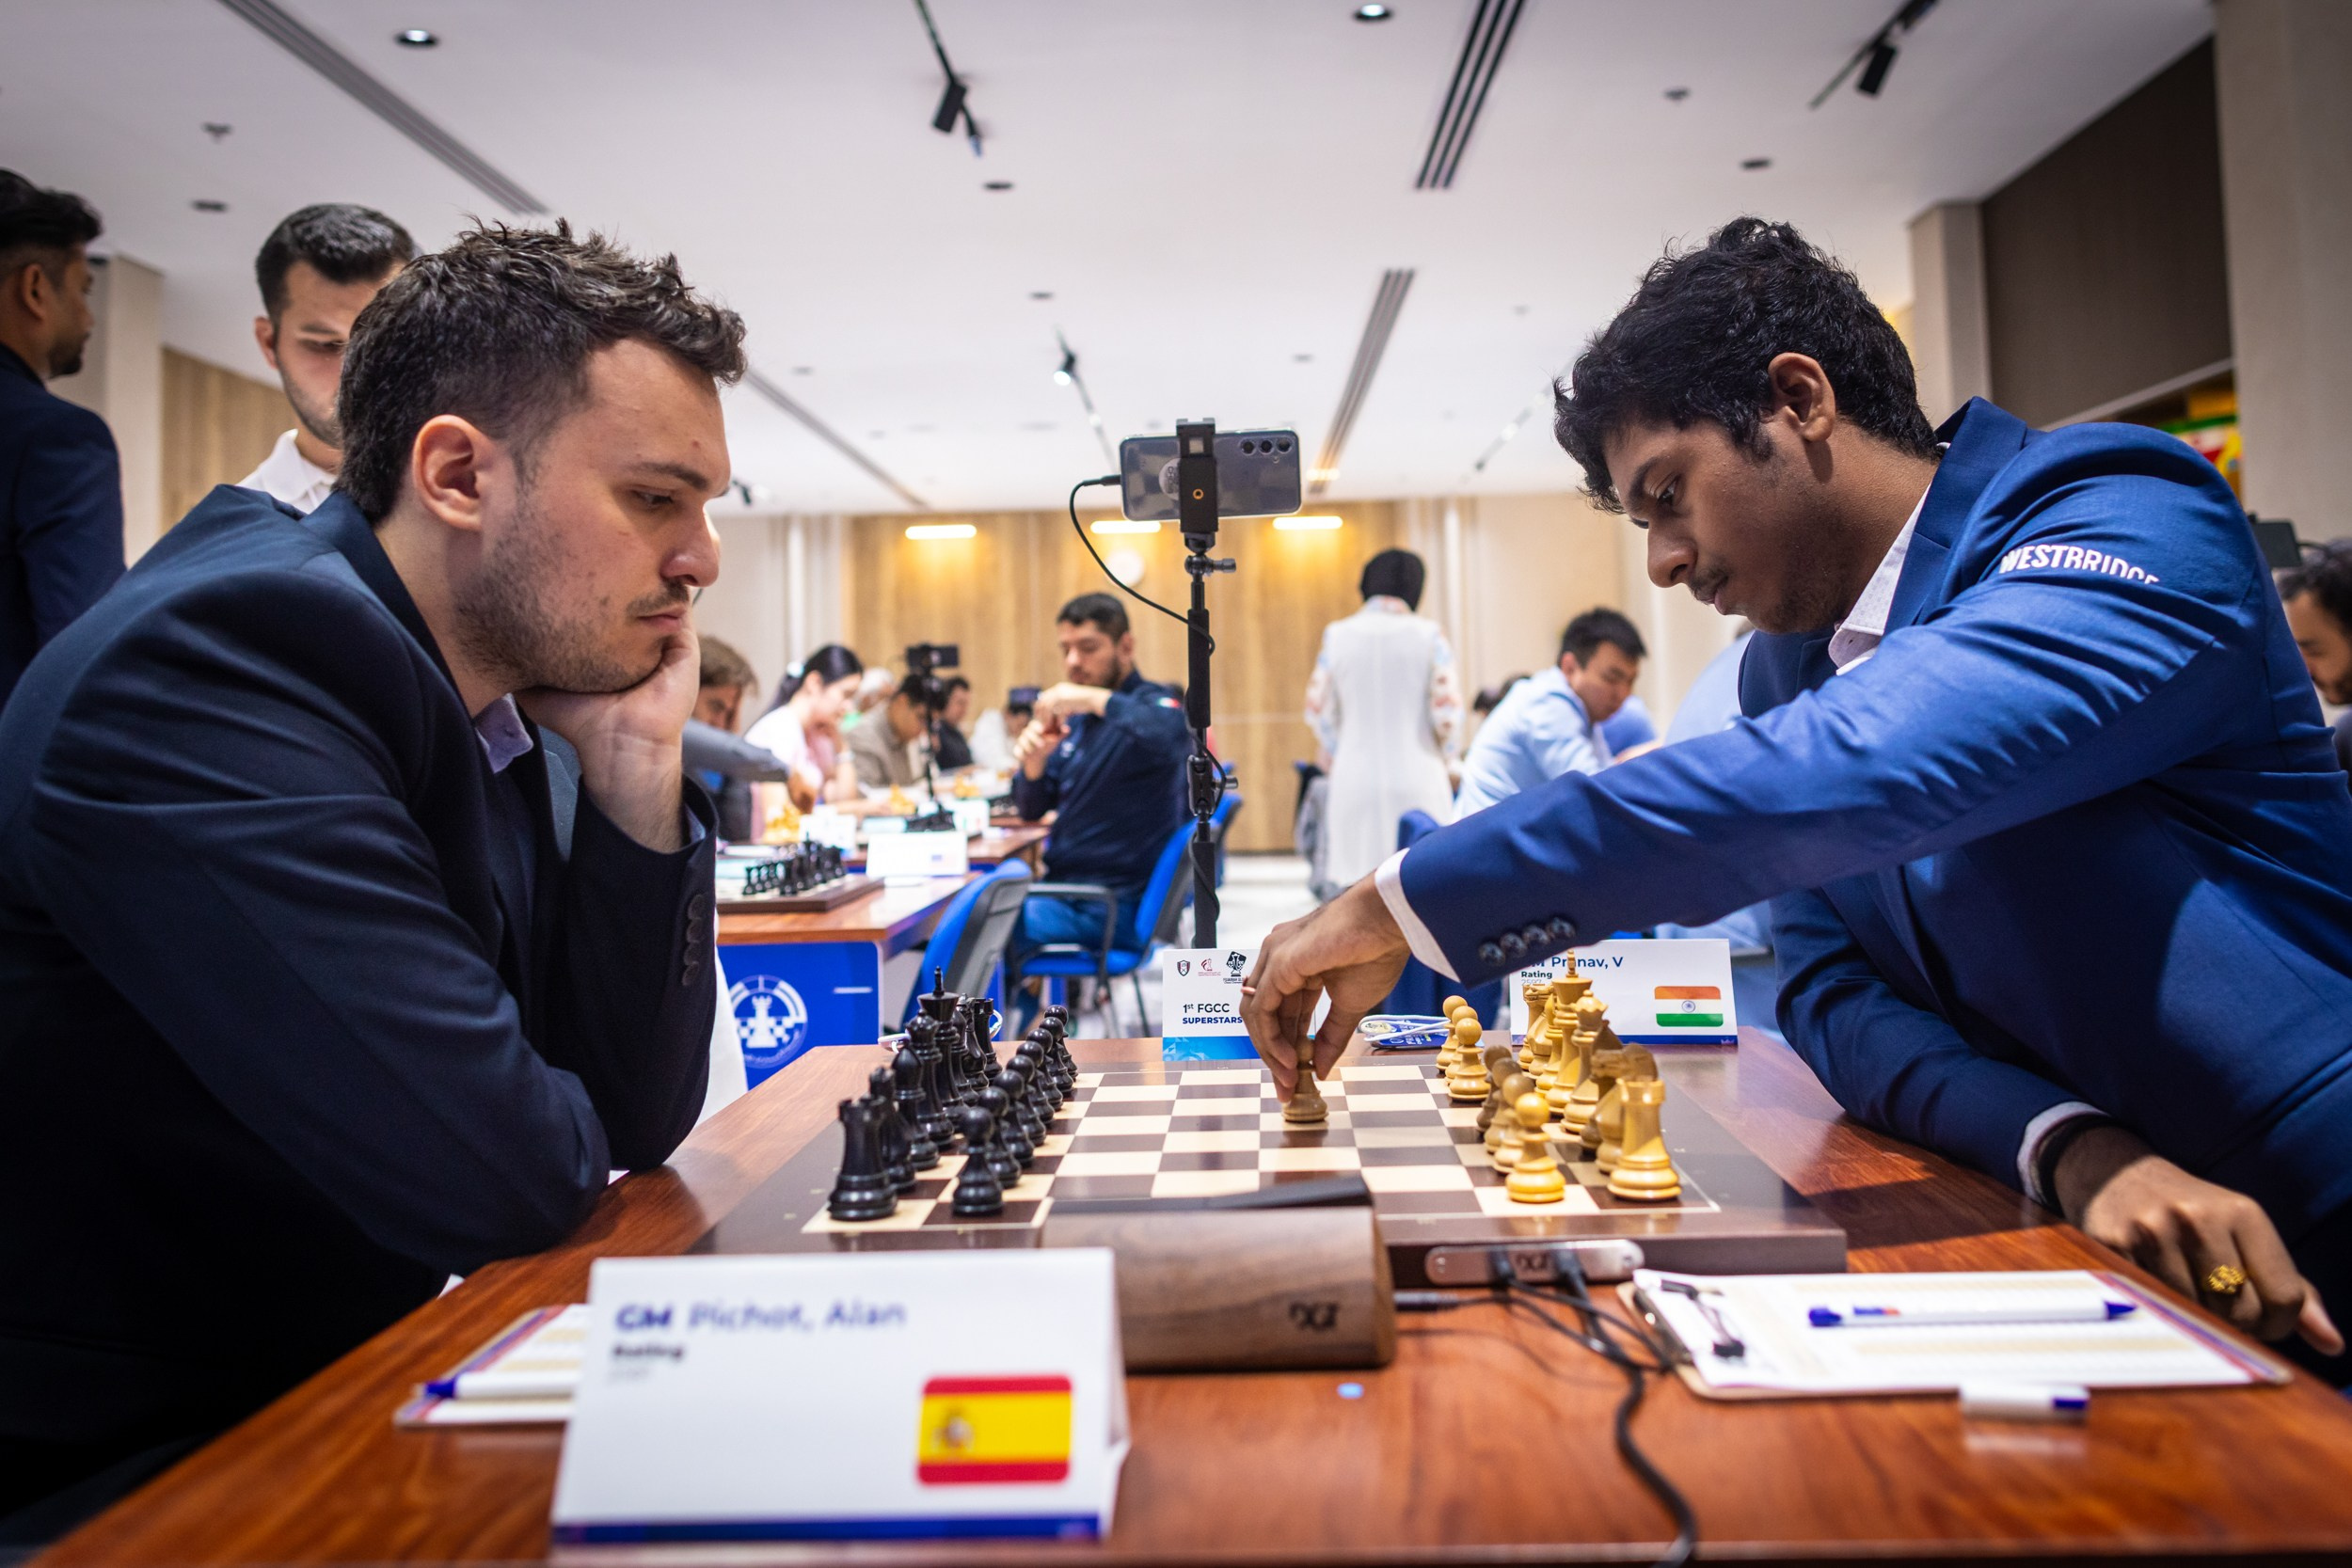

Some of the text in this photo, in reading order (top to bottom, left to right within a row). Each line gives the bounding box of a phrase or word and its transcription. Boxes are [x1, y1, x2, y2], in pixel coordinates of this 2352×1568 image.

[1551, 957, 1609, 970] Prnav,
[1612, 957, 1624, 968] V
[1520, 970, 1553, 980] Rating
[1197, 1003, 1231, 1014] FGCC
[1182, 1016, 1244, 1024] SUPERSTARS
[823, 1297, 907, 1331] Alan
